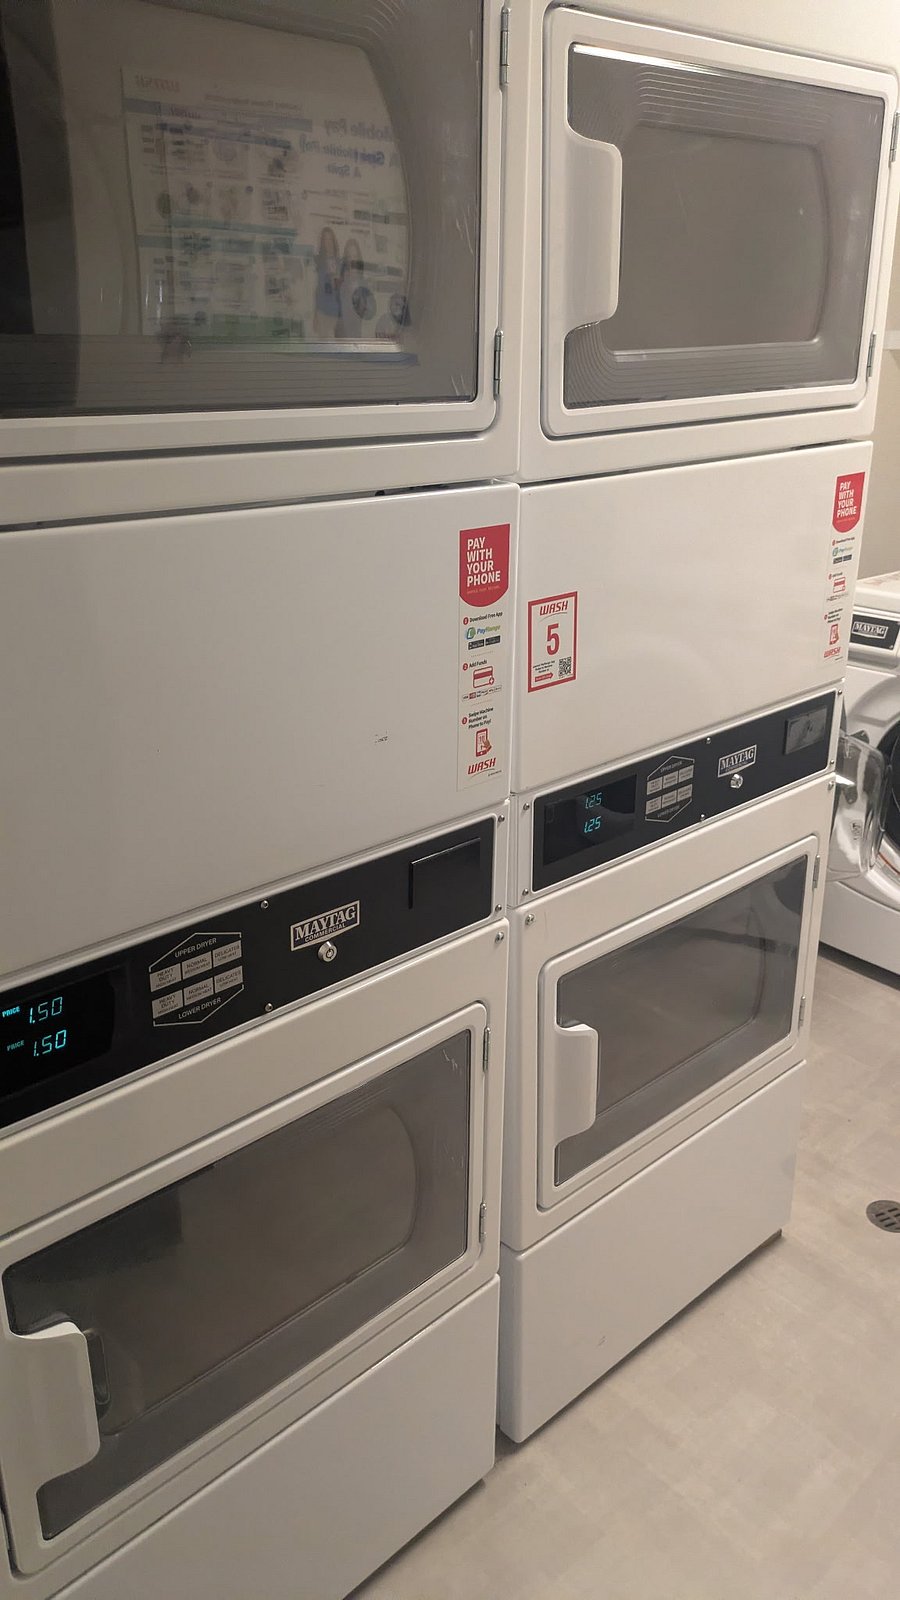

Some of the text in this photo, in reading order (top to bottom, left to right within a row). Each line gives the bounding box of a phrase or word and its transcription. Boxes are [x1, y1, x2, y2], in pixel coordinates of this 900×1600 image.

[840, 481, 851, 490] PAY
[838, 489, 854, 500] WITH
[838, 498, 854, 508] YOUR
[837, 506, 857, 518] PHONE
[467, 537, 485, 550] PAY
[467, 548, 492, 562] WITH
[467, 560, 493, 574] YOUR
[467, 571, 500, 587] PHONE
[540, 600, 568, 615] WASH
[470, 614, 487, 622] Download
[477, 626, 500, 634] PayRange
[854, 623, 884, 634] MAYTAG
[547, 623, 560, 655] 5
[468, 716, 482, 724] Number
[720, 748, 754, 769] MAYTAG
[468, 758, 496, 774] WASH
[295, 906, 356, 941] MAYTAG
[304, 922, 345, 942] COMMERCIAL
[174, 938, 217, 958] UPPER DRYER
[214, 945, 239, 958] DELICATES
[186, 958, 207, 968] NORMAL
[157, 968, 174, 977] HEAVY
[188, 984, 209, 994] NORMAL
[159, 995, 176, 1004] HEAVY
[161, 1000, 174, 1008] DUTY
[2, 996, 63, 1024] PRICE 1.50
[178, 1006, 200, 1019] LOWER
[201, 997, 221, 1010] DRYER
[7, 1030, 67, 1056] PRICE 1.50
